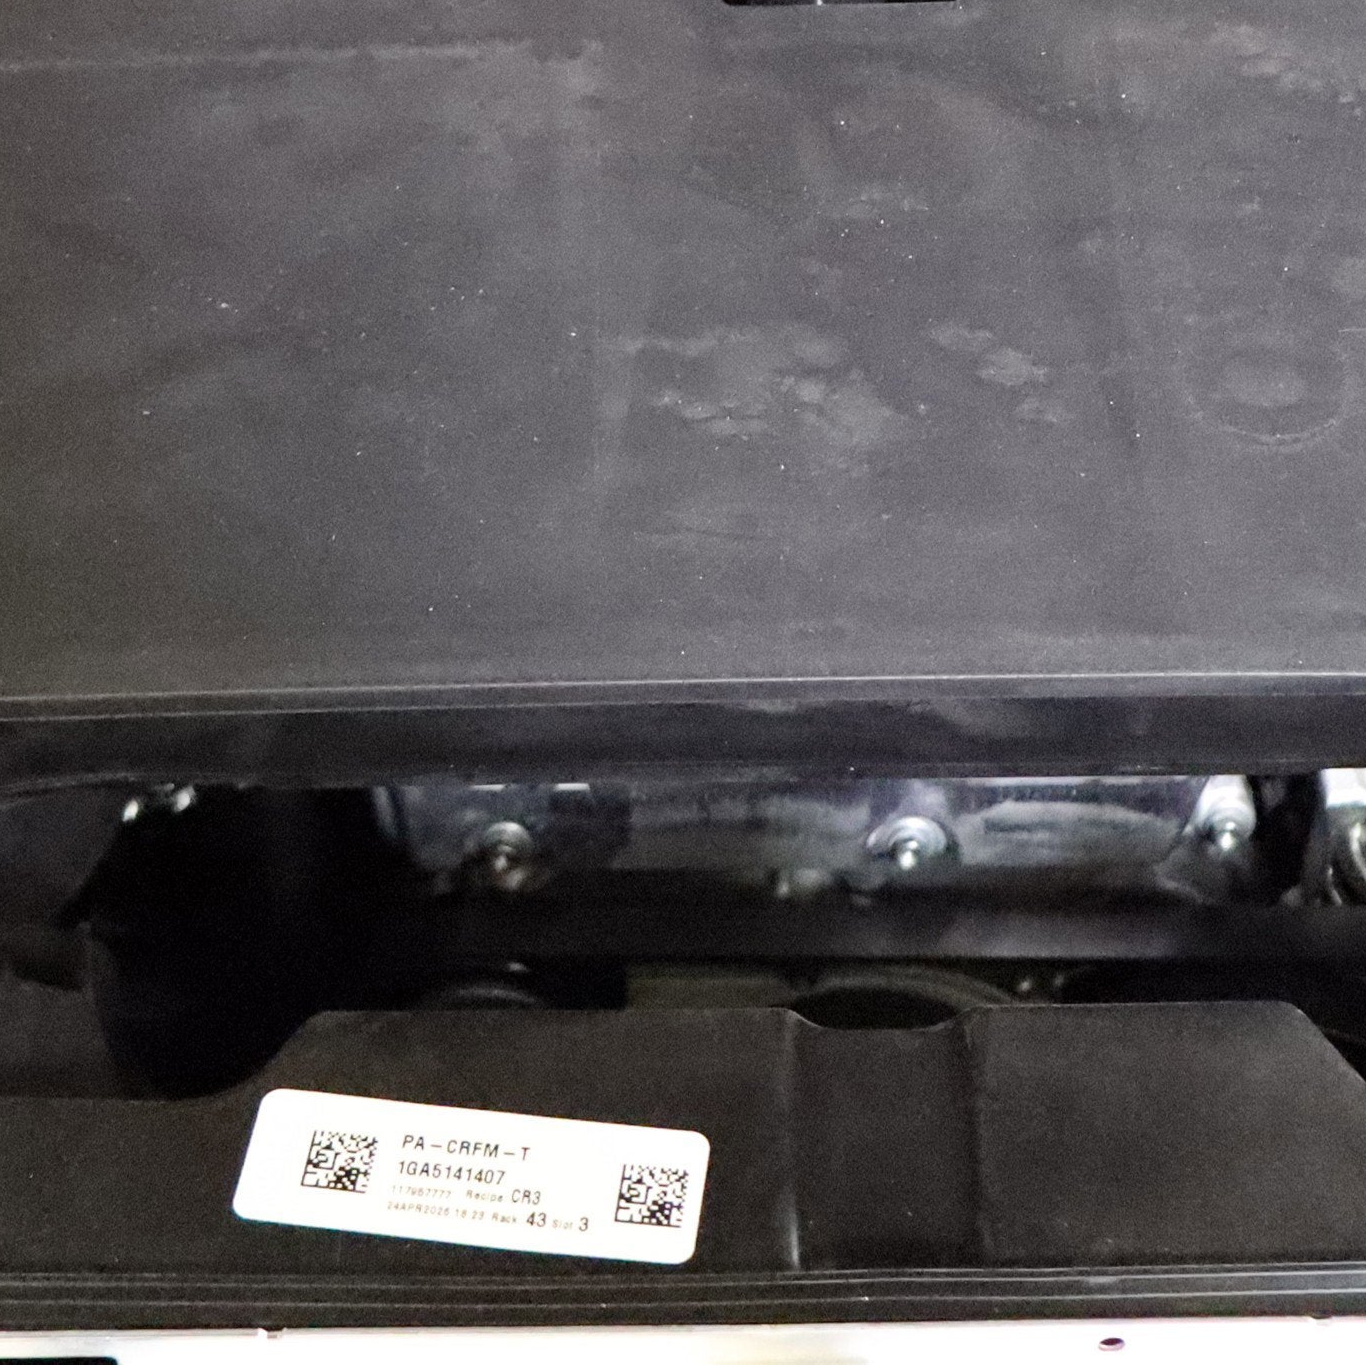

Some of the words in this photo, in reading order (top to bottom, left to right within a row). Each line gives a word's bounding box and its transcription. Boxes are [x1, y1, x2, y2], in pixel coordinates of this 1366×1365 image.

[398, 1160, 506, 1185] 1GA5141407
[465, 1189, 503, 1204] Recipe
[511, 1188, 541, 1206] CR3
[492, 1212, 517, 1223] Rack
[526, 1211, 547, 1227] 43
[578, 1216, 589, 1232] 3
